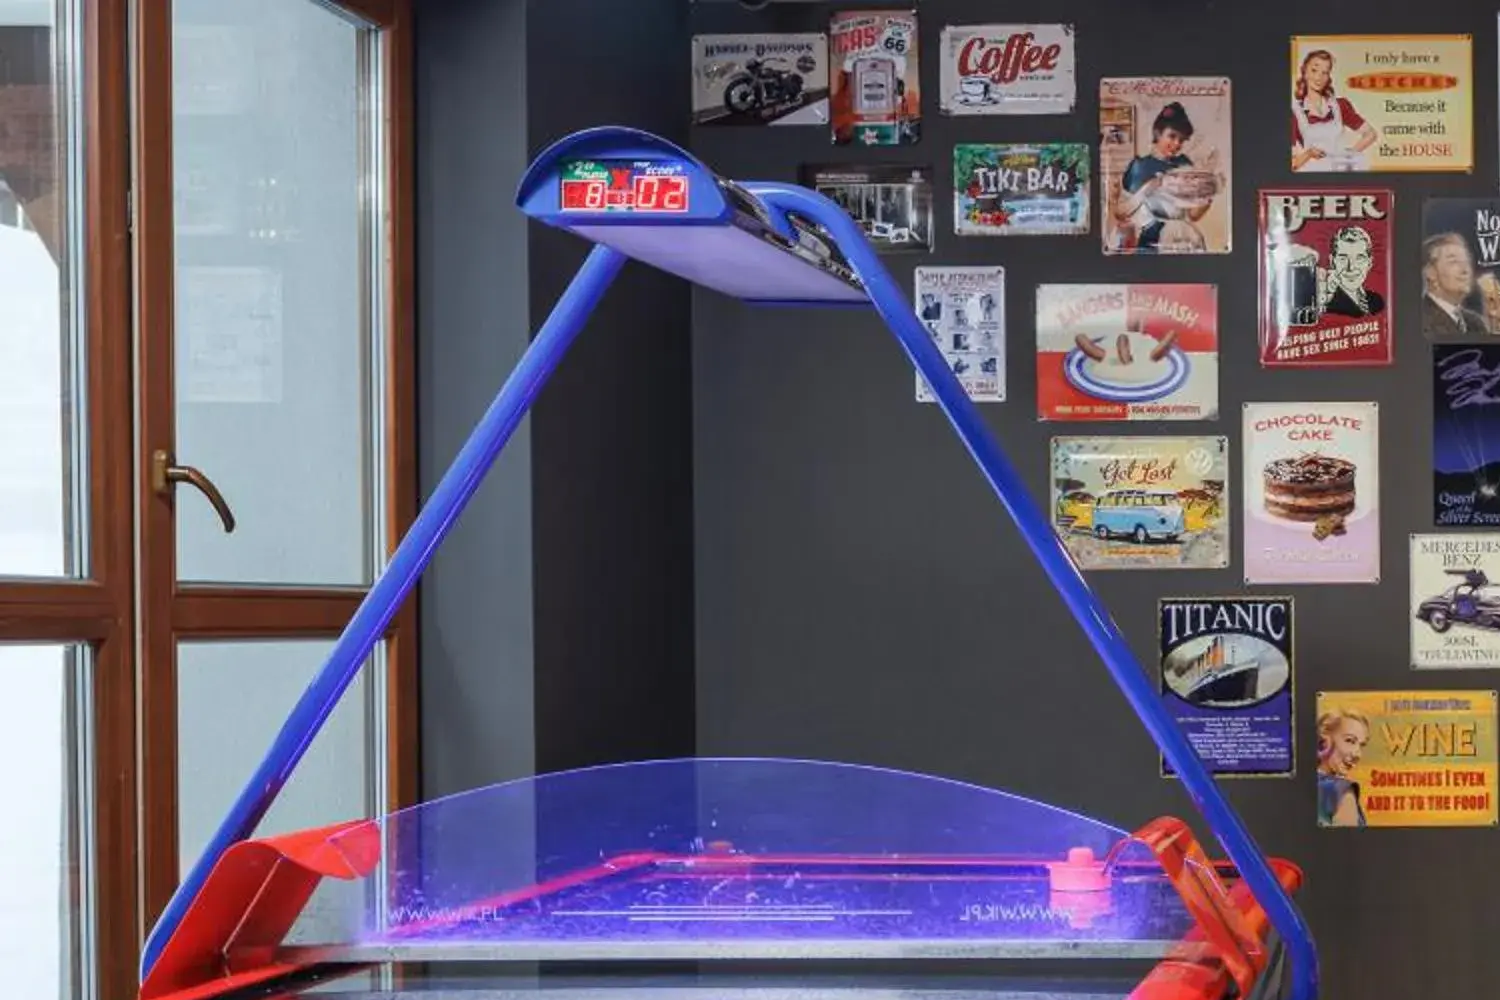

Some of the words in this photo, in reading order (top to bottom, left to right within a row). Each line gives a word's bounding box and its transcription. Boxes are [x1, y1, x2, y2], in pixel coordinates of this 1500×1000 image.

[838, 26, 878, 53] GAS
[884, 37, 906, 52] 66
[958, 32, 1061, 84] Coffee
[1365, 53, 1369, 63] I
[1373, 52, 1399, 64] only
[1402, 51, 1432, 63] have
[1385, 100, 1435, 113] Because
[1437, 100, 1446, 112] it
[1383, 125, 1415, 135] came
[1417, 121, 1446, 135] with
[1379, 144, 1400, 157] the
[1402, 144, 1453, 157] HOUSE
[974, 167, 1023, 193] TIKI
[1027, 166, 1069, 192] BAR
[1266, 195, 1387, 233] BEER
[1476, 210, 1500, 231] No
[1152, 297, 1199, 327] MASH
[1344, 320, 1380, 336] PEOPLE
[1303, 343, 1321, 356] SEX
[1323, 338, 1350, 353] SINCE
[1255, 413, 1362, 432] CHOCOLATE
[1288, 429, 1334, 441] CAKE
[1100, 458, 1137, 488] Get
[1137, 458, 1178, 485] Lost
[1437, 510, 1471, 524] Silver
[1443, 554, 1483, 566] BENZ
[1164, 603, 1286, 644] TITANIC
[1383, 722, 1478, 757] WINE
[1370, 769, 1443, 788] SOMETIMES
[1453, 772, 1486, 786] EVEN
[1393, 795, 1406, 810] IT
[1408, 795, 1426, 810] TO
[1428, 795, 1450, 810] THE
